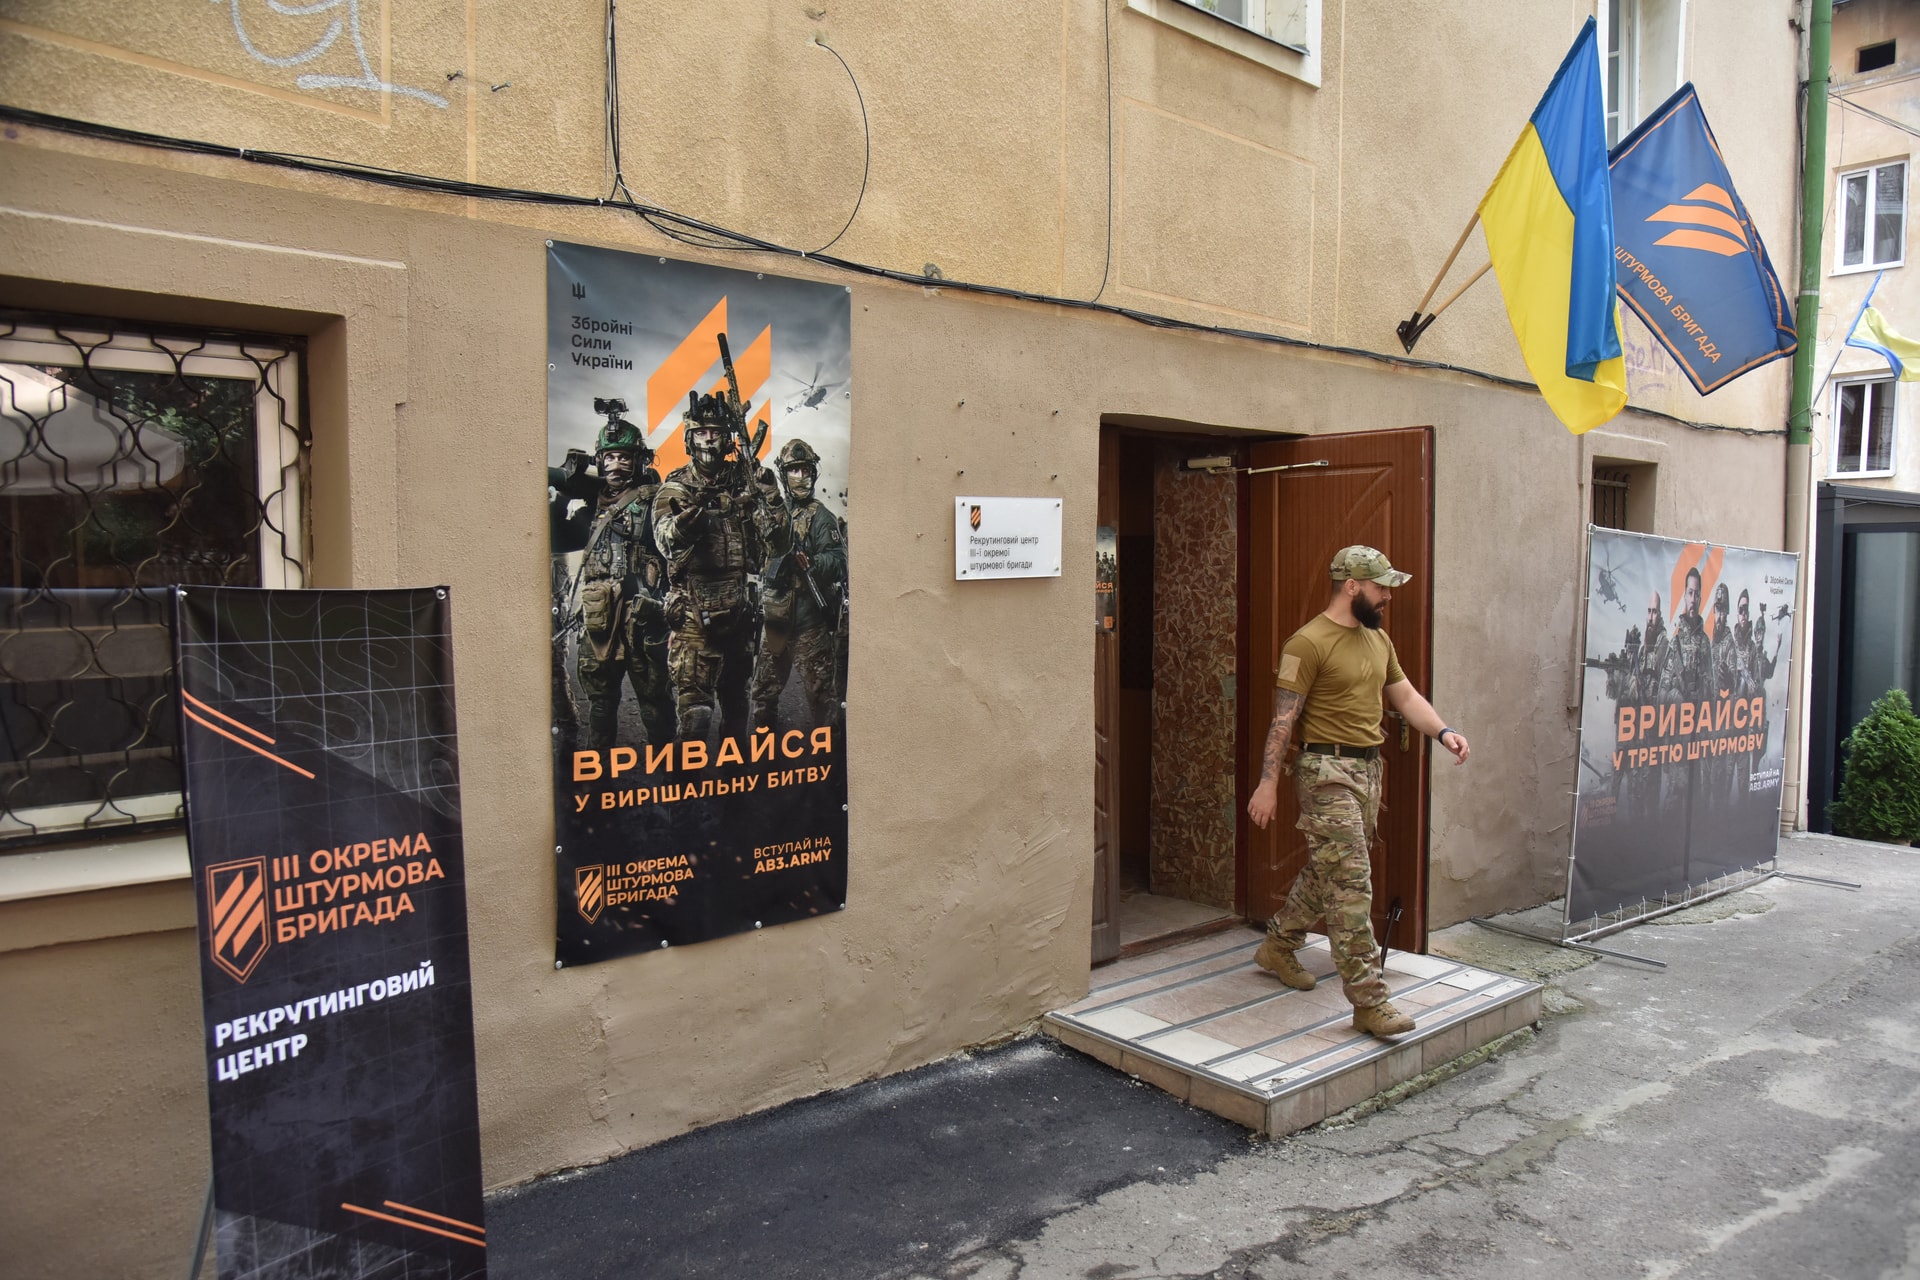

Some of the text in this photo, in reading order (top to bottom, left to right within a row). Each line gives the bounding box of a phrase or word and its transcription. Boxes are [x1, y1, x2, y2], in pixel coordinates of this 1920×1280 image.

[572, 316, 633, 336] Збройні
[1670, 304, 1722, 364] БРИГАДА
[572, 334, 612, 351] Сили
[571, 352, 633, 371] України
[970, 535, 1039, 546] Рекрутинговий центр
[984, 547, 1010, 558] окремої
[1006, 560, 1033, 570] бригади
[1618, 688, 1764, 742] ВРИВАЙСЯ
[573, 725, 832, 782] ВРИВАЙСЯ
[1612, 732, 1764, 771] У ТРЕТЮ ШТУРМОВУ
[574, 765, 832, 812] У ВИРІШАЛЬНУ БИТВУ
[309, 832, 432, 875] ОКРЕМА
[754, 836, 832, 859] ВСТУПАЙ НА
[606, 867, 694, 892] ШТУРМОВА
[625, 854, 689, 875] ОКРЕМА
[274, 858, 445, 912] ШТУРМОВА
[606, 886, 679, 907] БРИГАДА
[276, 892, 415, 943] БРИГАДА
[215, 960, 435, 1048] РЕКРУТИНГОВИЙ
[217, 1033, 308, 1082] ЦЕНТР
